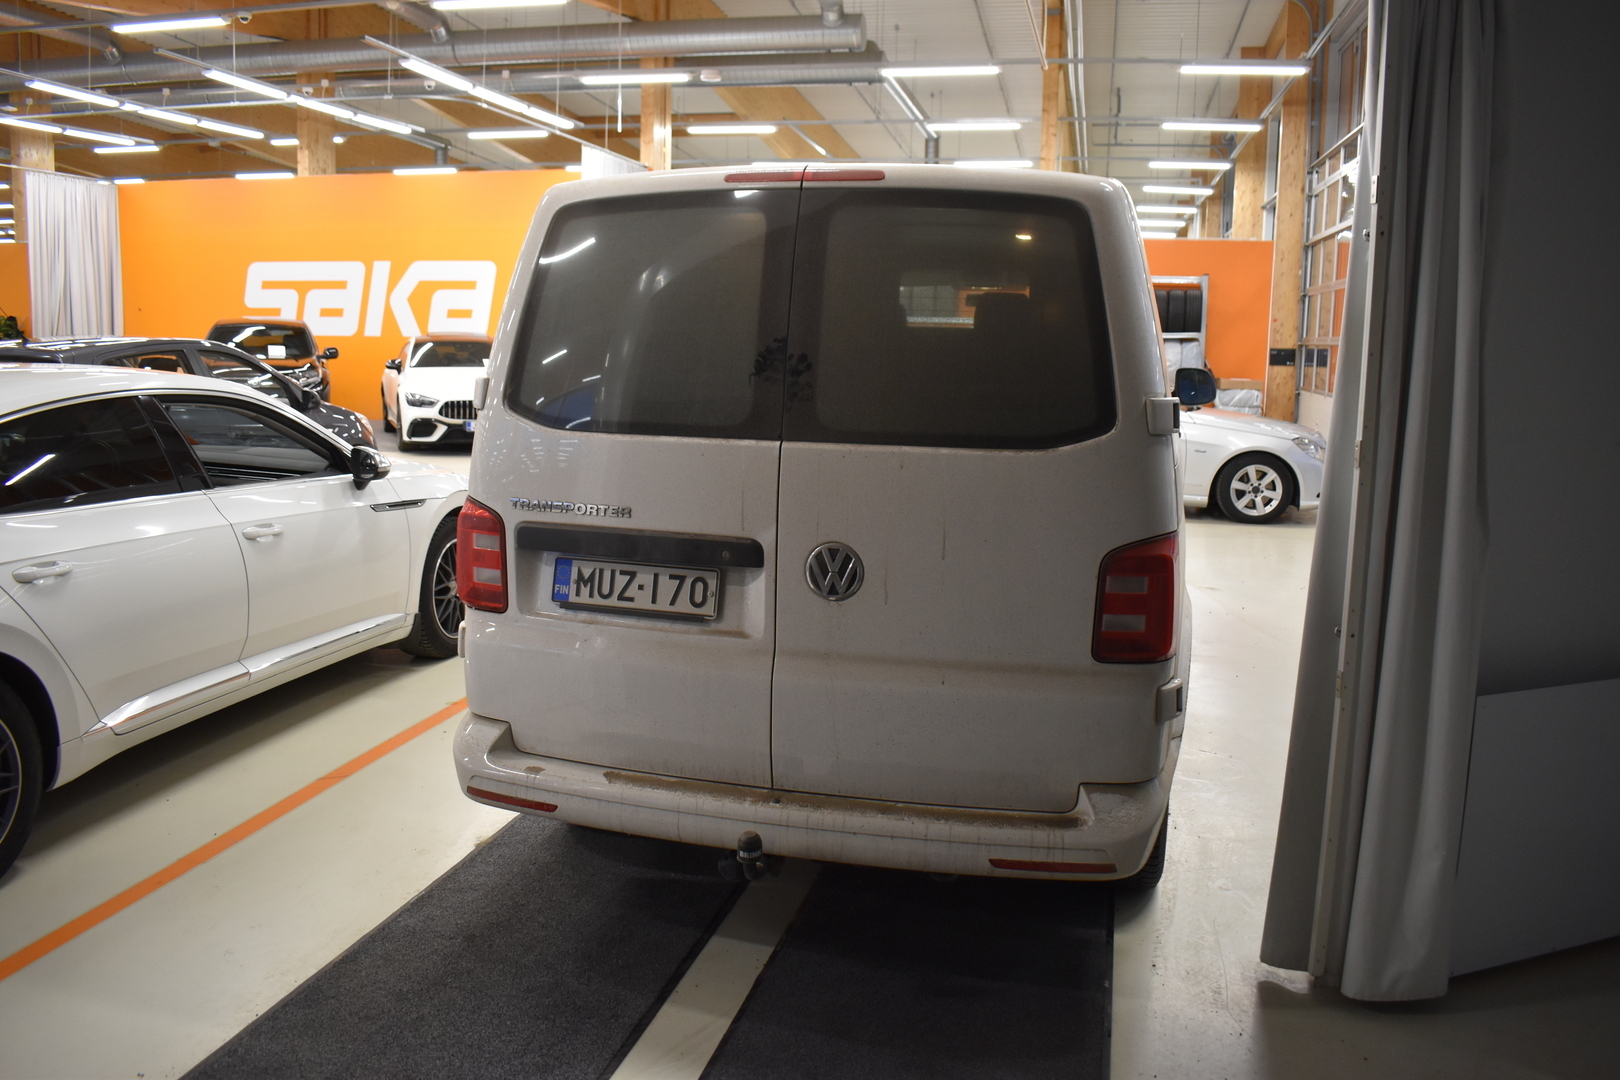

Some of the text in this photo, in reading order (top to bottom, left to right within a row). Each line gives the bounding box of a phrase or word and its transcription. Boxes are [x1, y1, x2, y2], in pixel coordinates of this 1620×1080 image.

[510, 497, 632, 518] TRANSPORTER
[554, 584, 569, 594] FIN
[575, 566, 709, 608] MUZ-170
